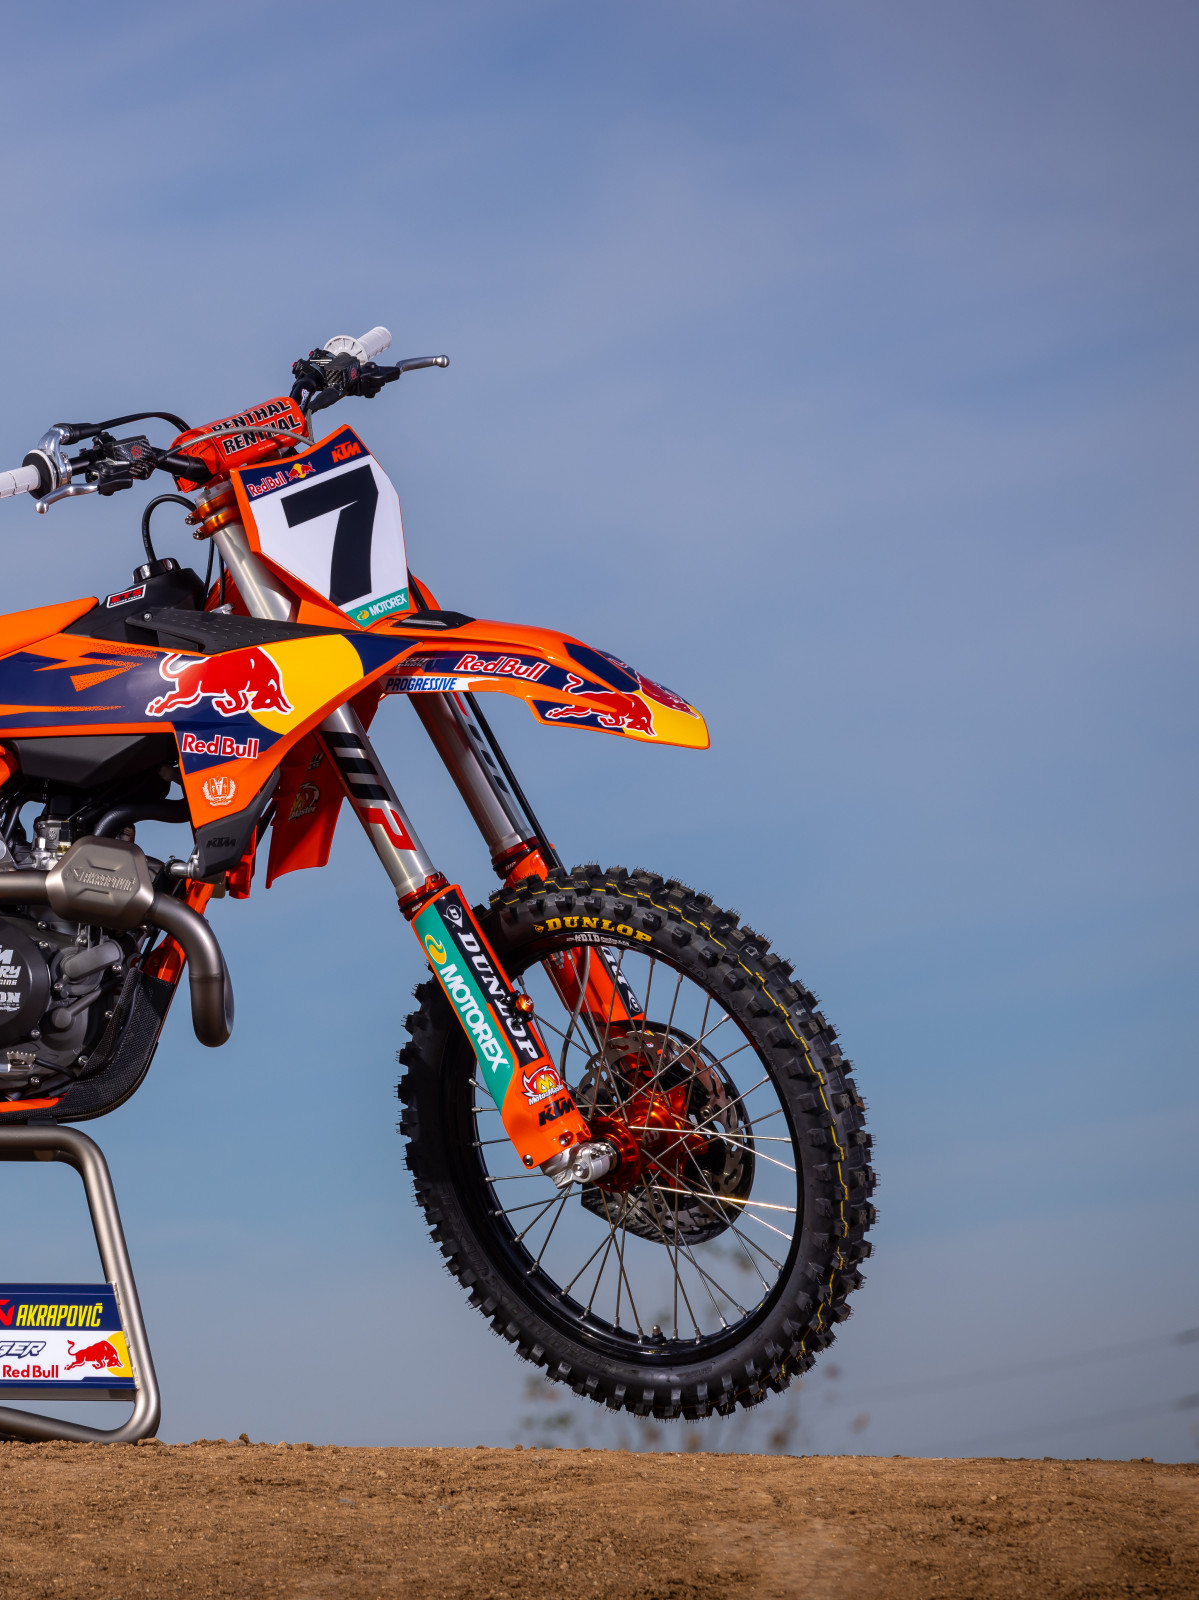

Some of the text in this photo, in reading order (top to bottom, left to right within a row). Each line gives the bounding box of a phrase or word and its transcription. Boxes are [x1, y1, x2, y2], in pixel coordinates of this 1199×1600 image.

[331, 441, 362, 464] KTM
[280, 464, 379, 607] 7
[368, 593, 408, 616] MOTOREX
[385, 677, 458, 691] PROGRESSIVE
[206, 837, 237, 849] KTM
[546, 915, 653, 942] DUNLOP
[439, 963, 509, 1073] MOTOREX
[538, 1096, 576, 1127] KTM
[2, 1364, 59, 1378] Red Bull
